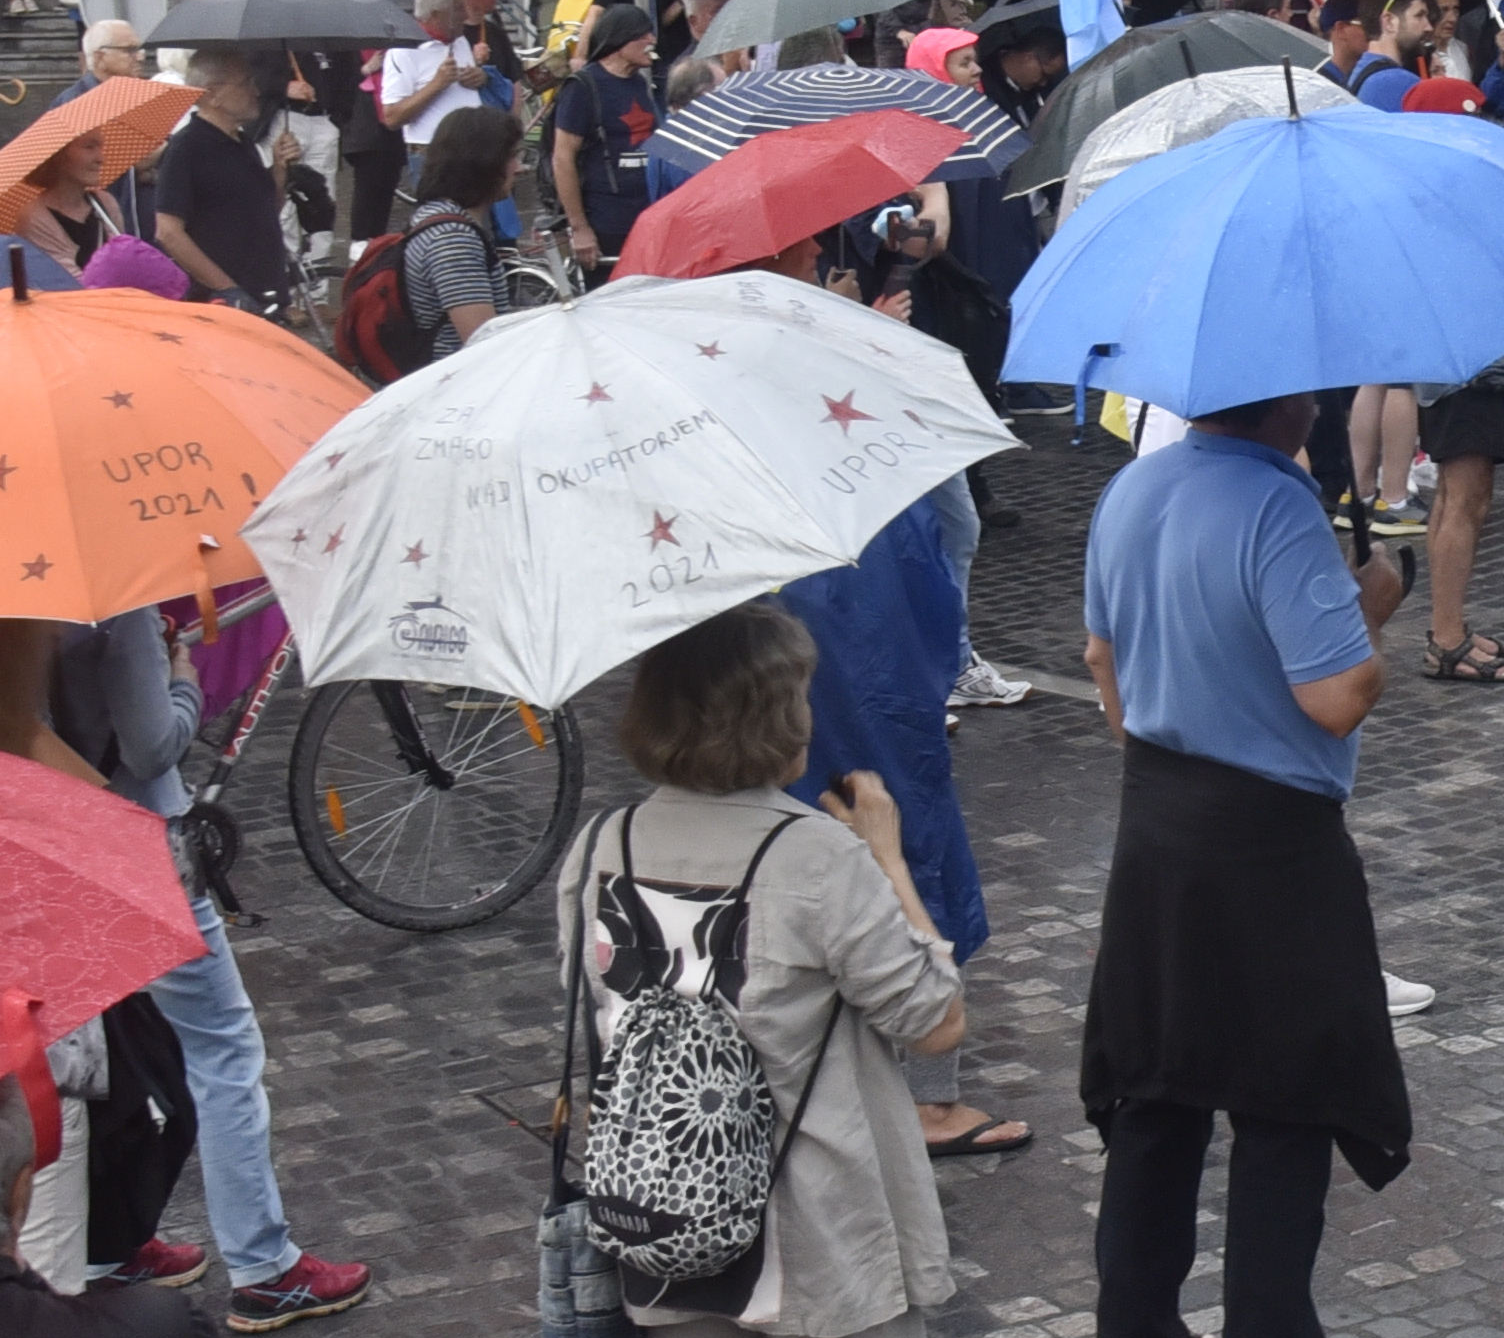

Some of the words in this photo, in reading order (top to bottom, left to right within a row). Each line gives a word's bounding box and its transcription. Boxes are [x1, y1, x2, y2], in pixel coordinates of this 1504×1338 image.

[436, 406, 476, 425] ZA
[101, 441, 213, 483] UPOR
[537, 408, 718, 495] OKUPATORJEM
[620, 542, 722, 608] 2021
[597, 1204, 652, 1234] GRANADA
